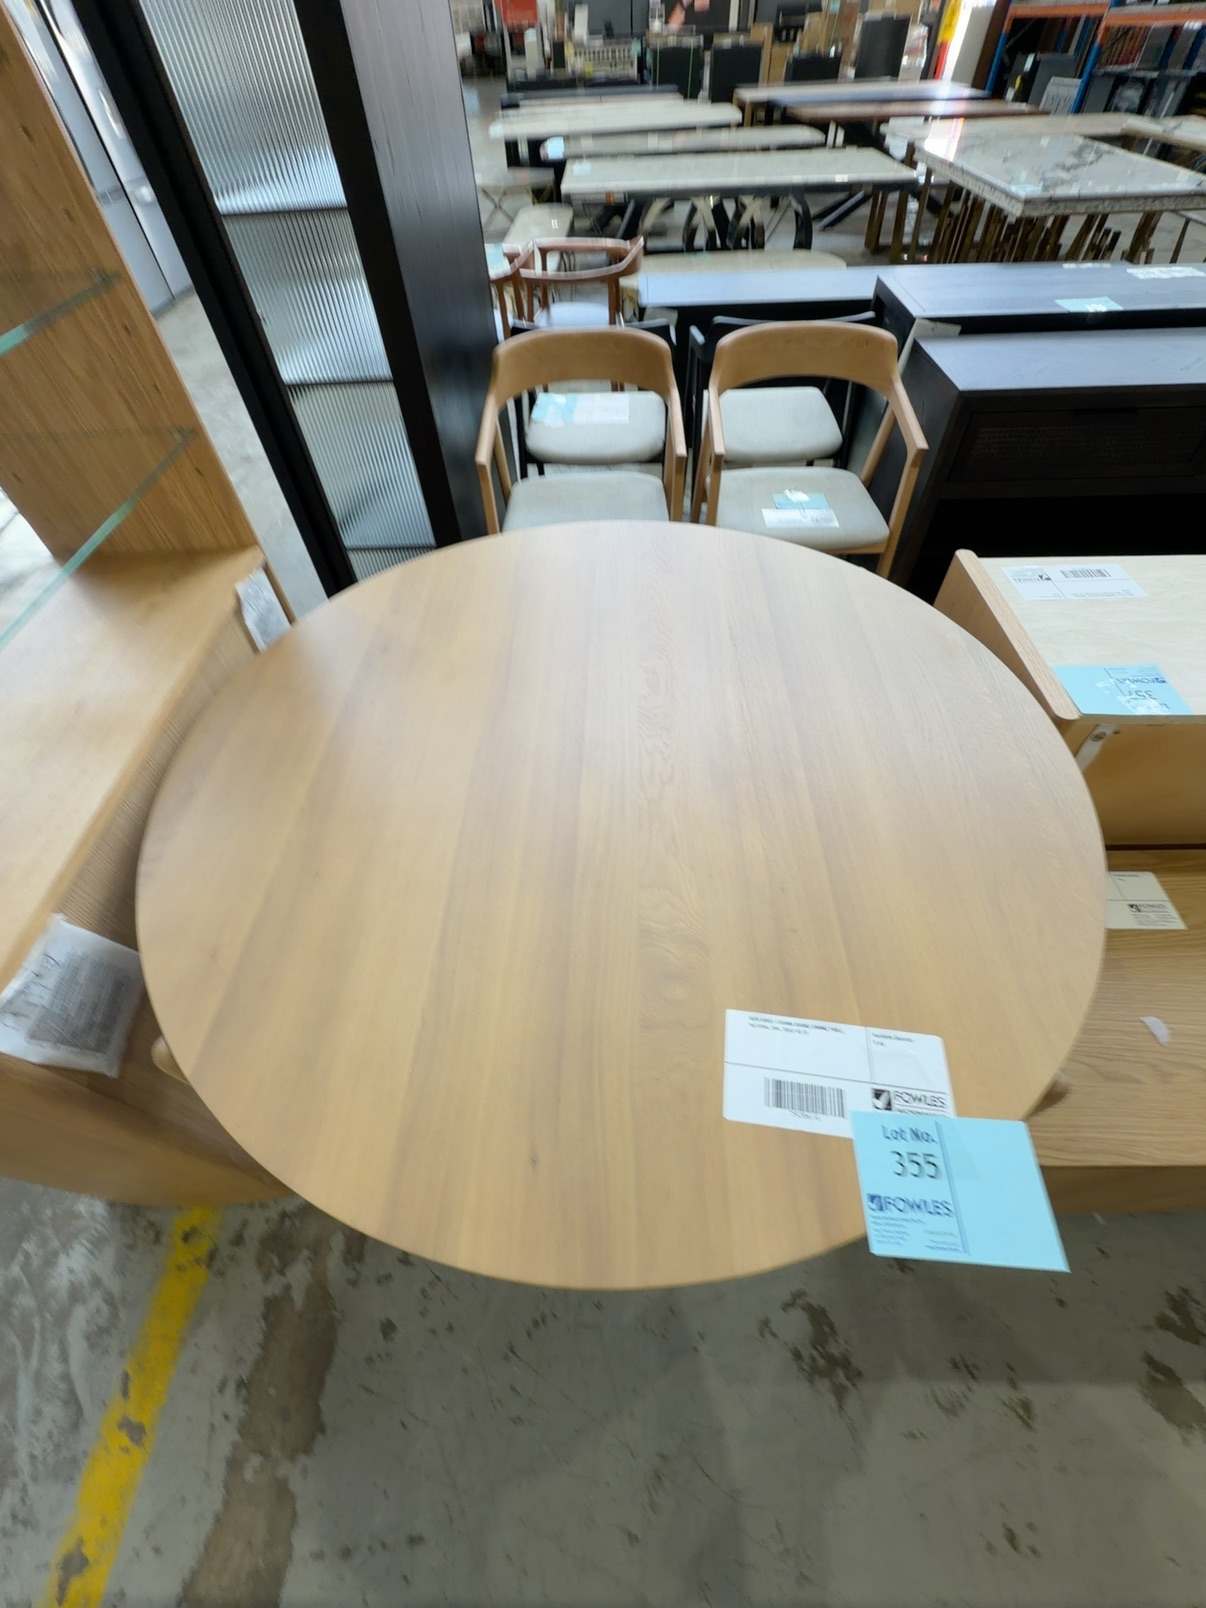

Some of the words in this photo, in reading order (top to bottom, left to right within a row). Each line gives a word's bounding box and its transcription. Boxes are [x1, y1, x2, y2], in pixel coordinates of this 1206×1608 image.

[893, 1089, 949, 1109] FOWLES
[881, 1125, 909, 1142] Lot
[909, 1126, 939, 1144] No.
[890, 1150, 941, 1179] 355
[882, 1195, 954, 1218] FOWLES
